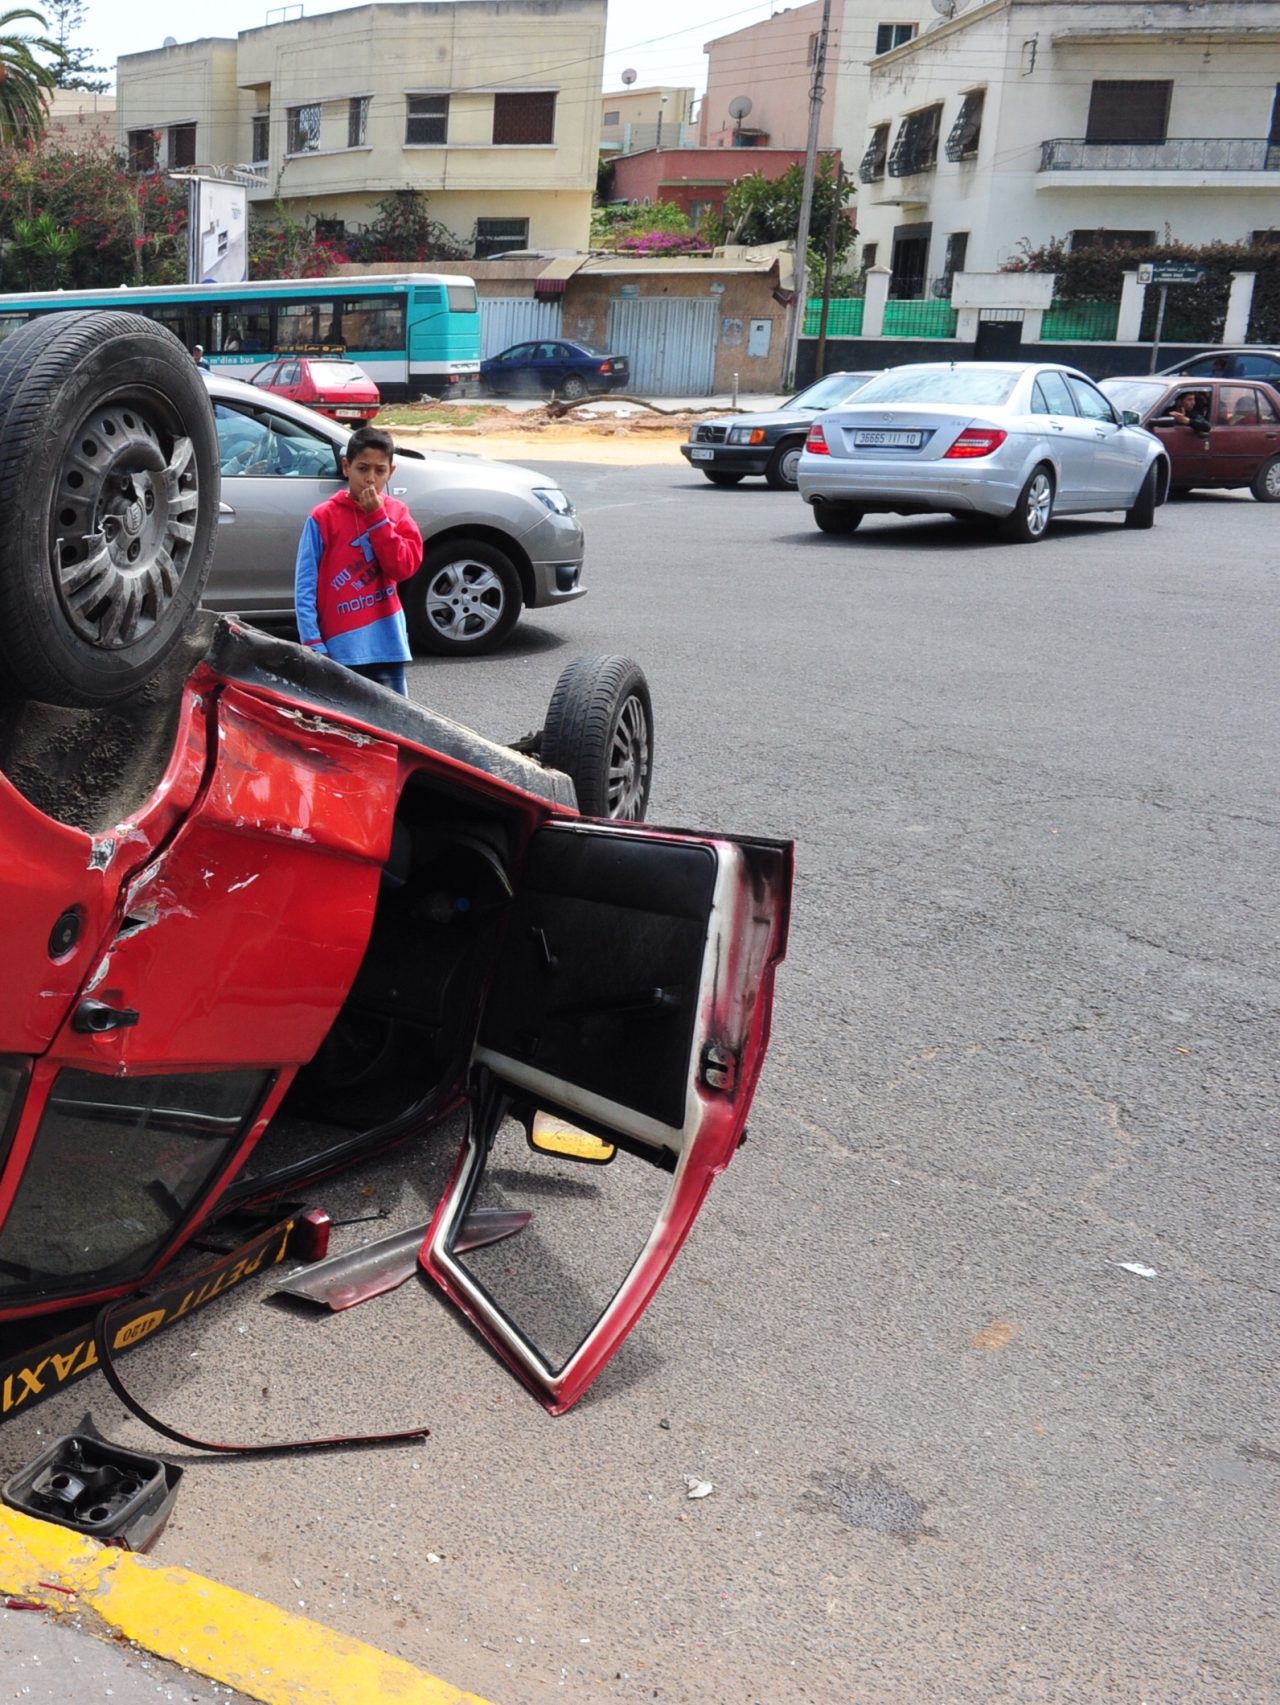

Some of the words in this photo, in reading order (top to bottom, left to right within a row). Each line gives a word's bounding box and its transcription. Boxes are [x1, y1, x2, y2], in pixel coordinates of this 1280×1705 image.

[239, 355, 254, 364] bus
[330, 568, 352, 592] YOU
[164, 1244, 270, 1325] PETIT
[122, 1316, 156, 1343] 4120
[2, 1339, 99, 1414] TAXI
